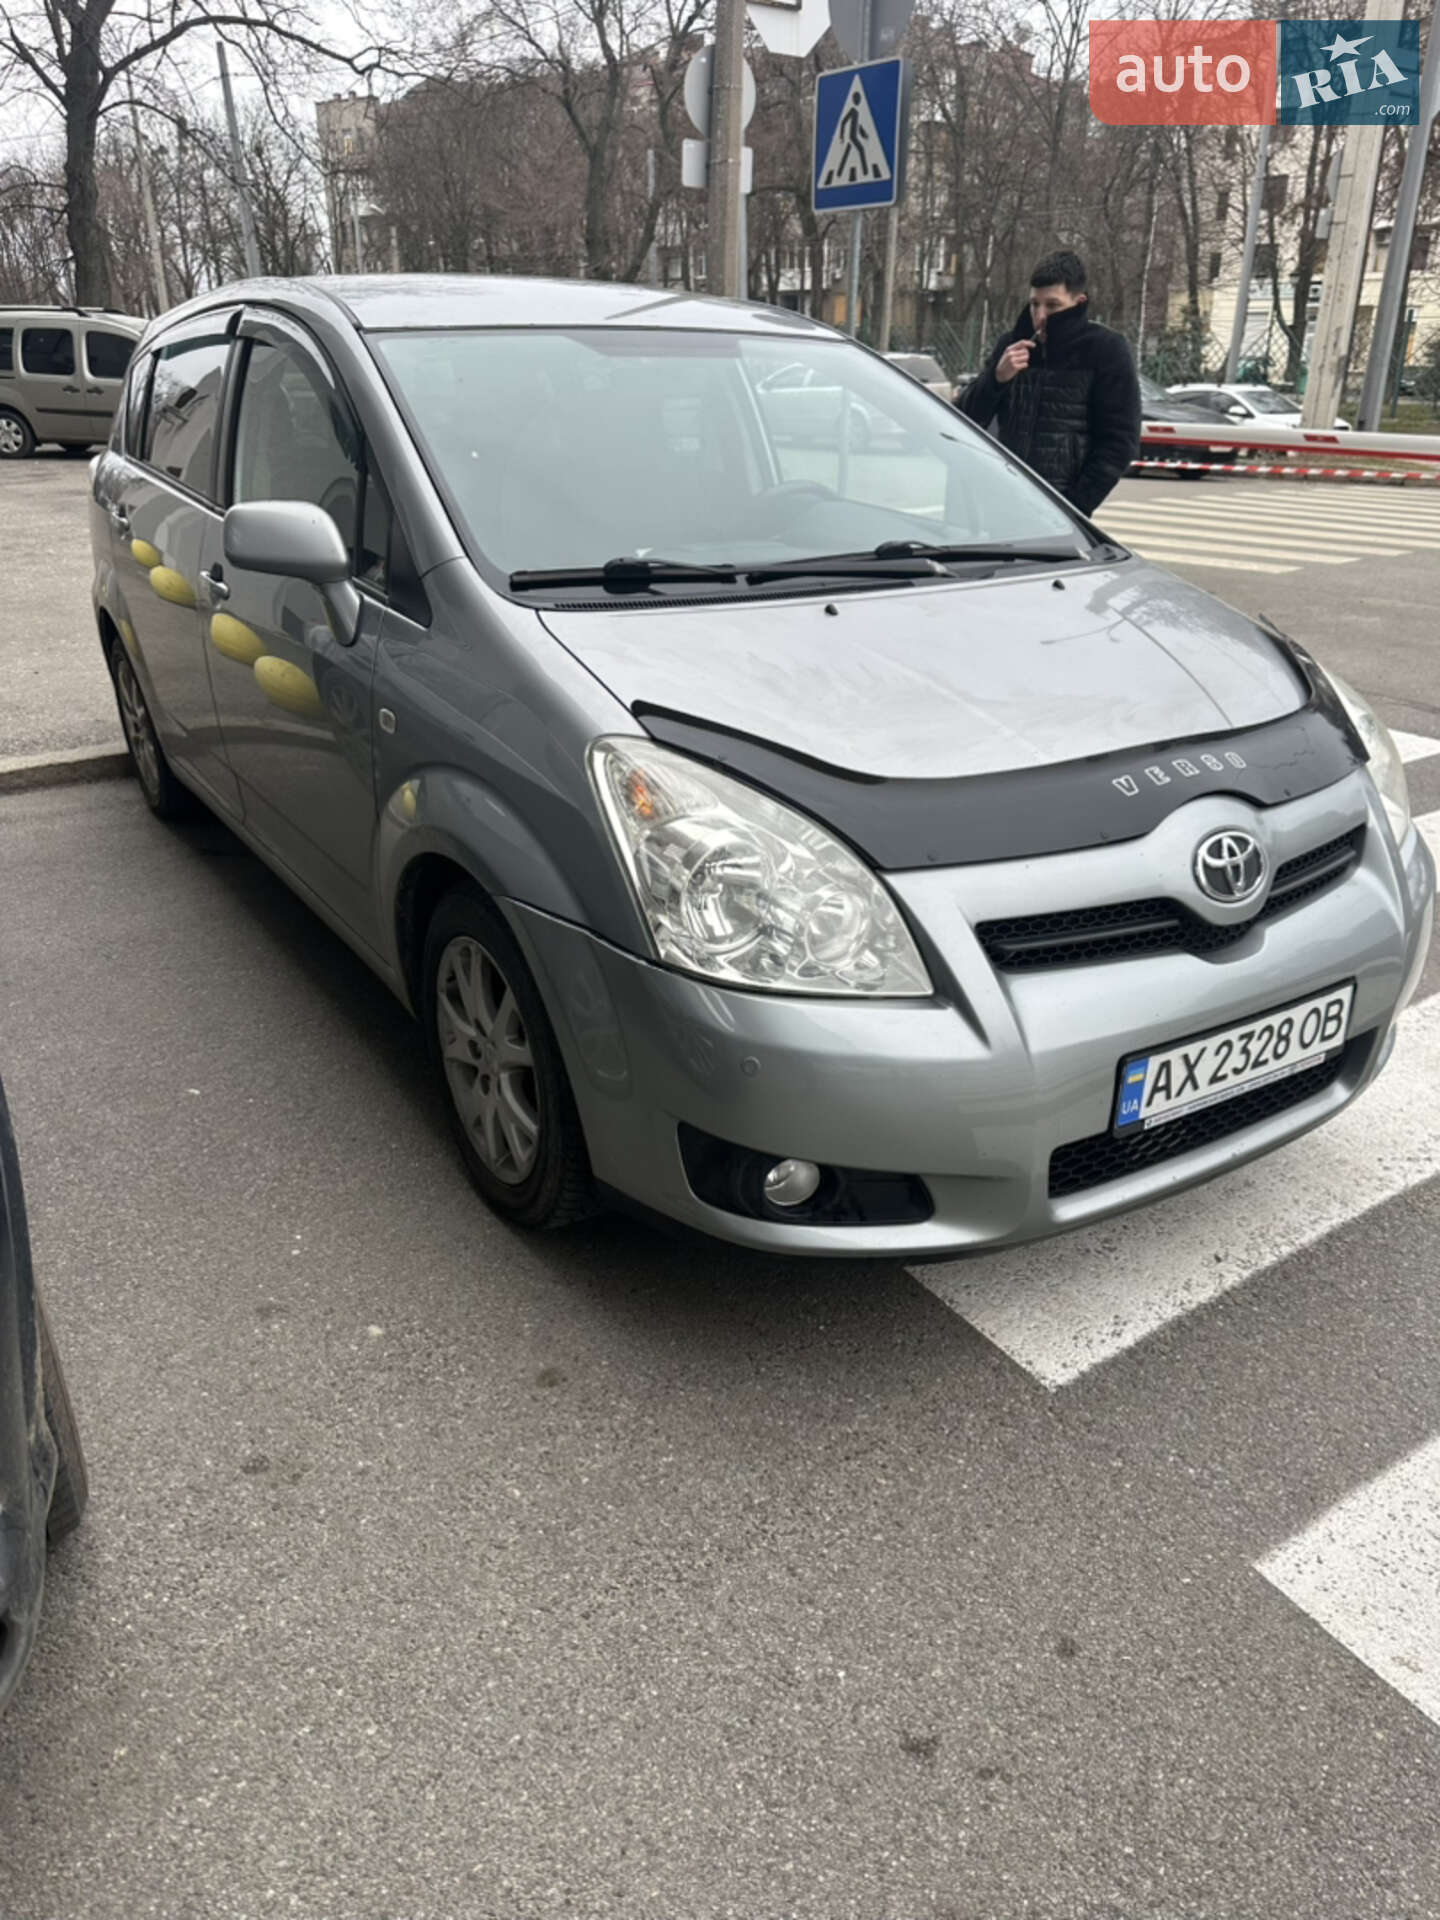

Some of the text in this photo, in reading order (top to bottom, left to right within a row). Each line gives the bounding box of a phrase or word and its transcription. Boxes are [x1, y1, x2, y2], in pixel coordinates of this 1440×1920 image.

[1112, 751, 1247, 797] VERSO
[1145, 1046, 1208, 1108] AX
[1207, 1017, 1295, 1086] 2328
[1299, 998, 1344, 1050] OB
[1121, 1099, 1140, 1115] UA
